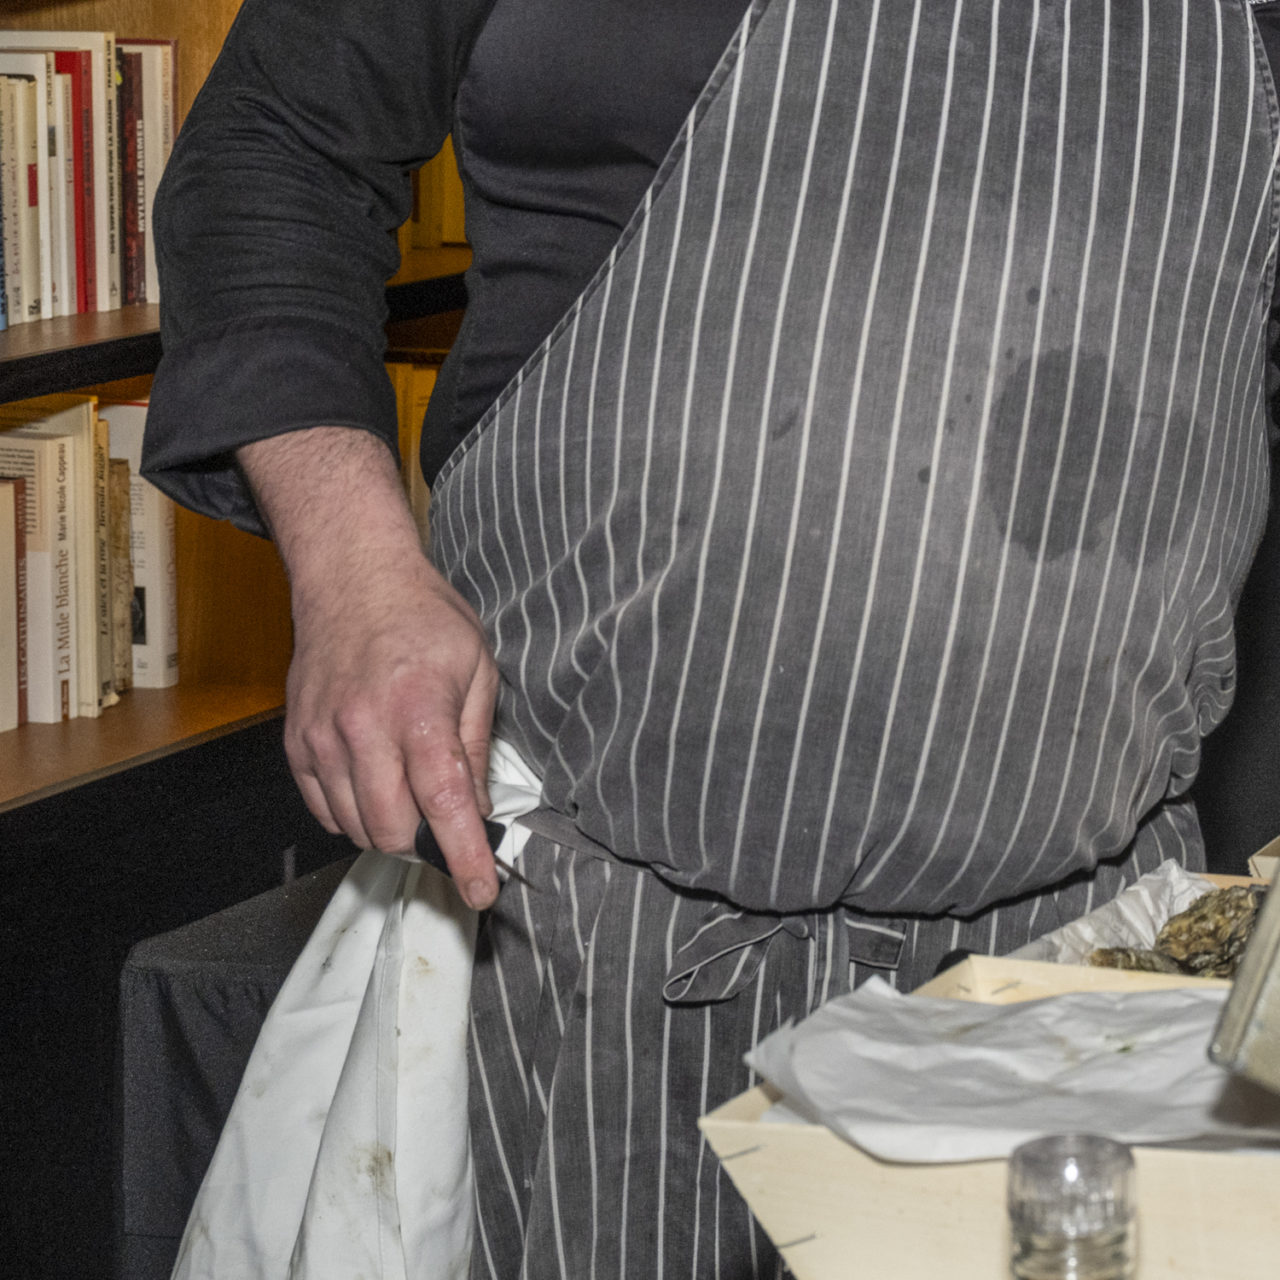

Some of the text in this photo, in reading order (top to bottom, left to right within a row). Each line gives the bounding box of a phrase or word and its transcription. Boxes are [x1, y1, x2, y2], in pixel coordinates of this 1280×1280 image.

[136, 119, 144, 175] FARMER
[56, 442, 67, 541] Marie Nicole Cappeau
[55, 548, 70, 609] blanche
[57, 612, 70, 650] Mule
[57, 655, 71, 675] La
